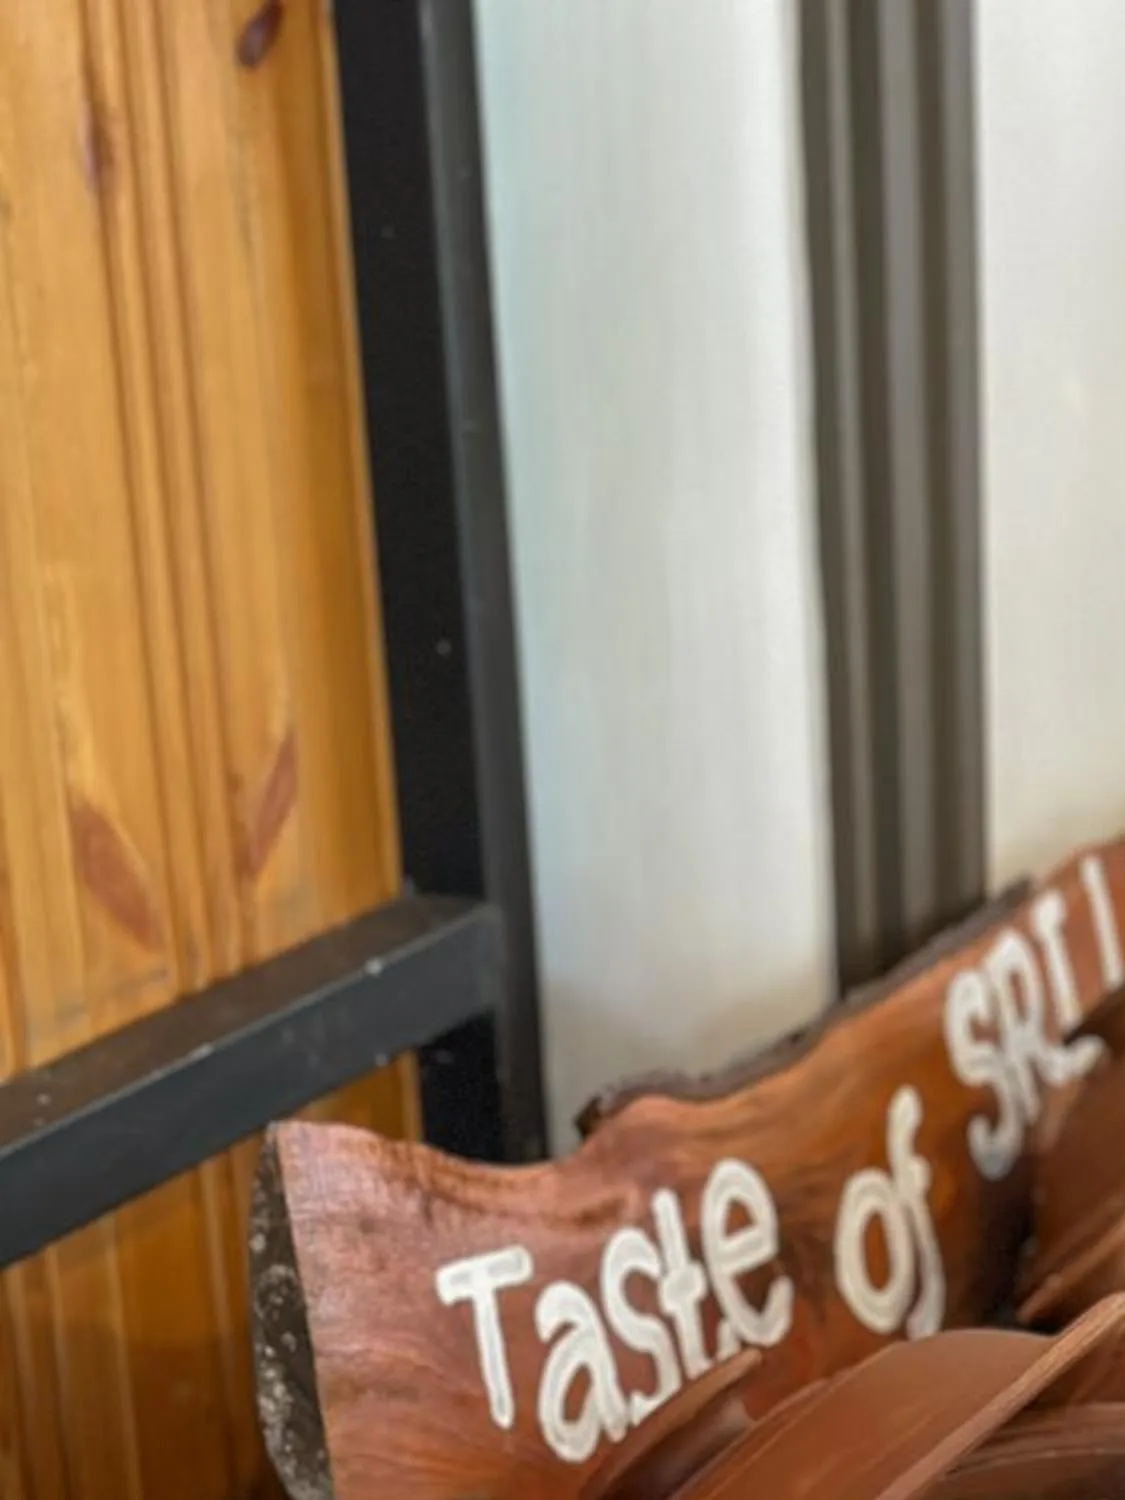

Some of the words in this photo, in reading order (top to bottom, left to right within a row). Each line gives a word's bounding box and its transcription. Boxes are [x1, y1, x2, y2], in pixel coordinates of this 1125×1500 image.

[435, 1158, 793, 1463] Taste
[834, 1086, 946, 1340] of
[943, 886, 1108, 1179] SRI
